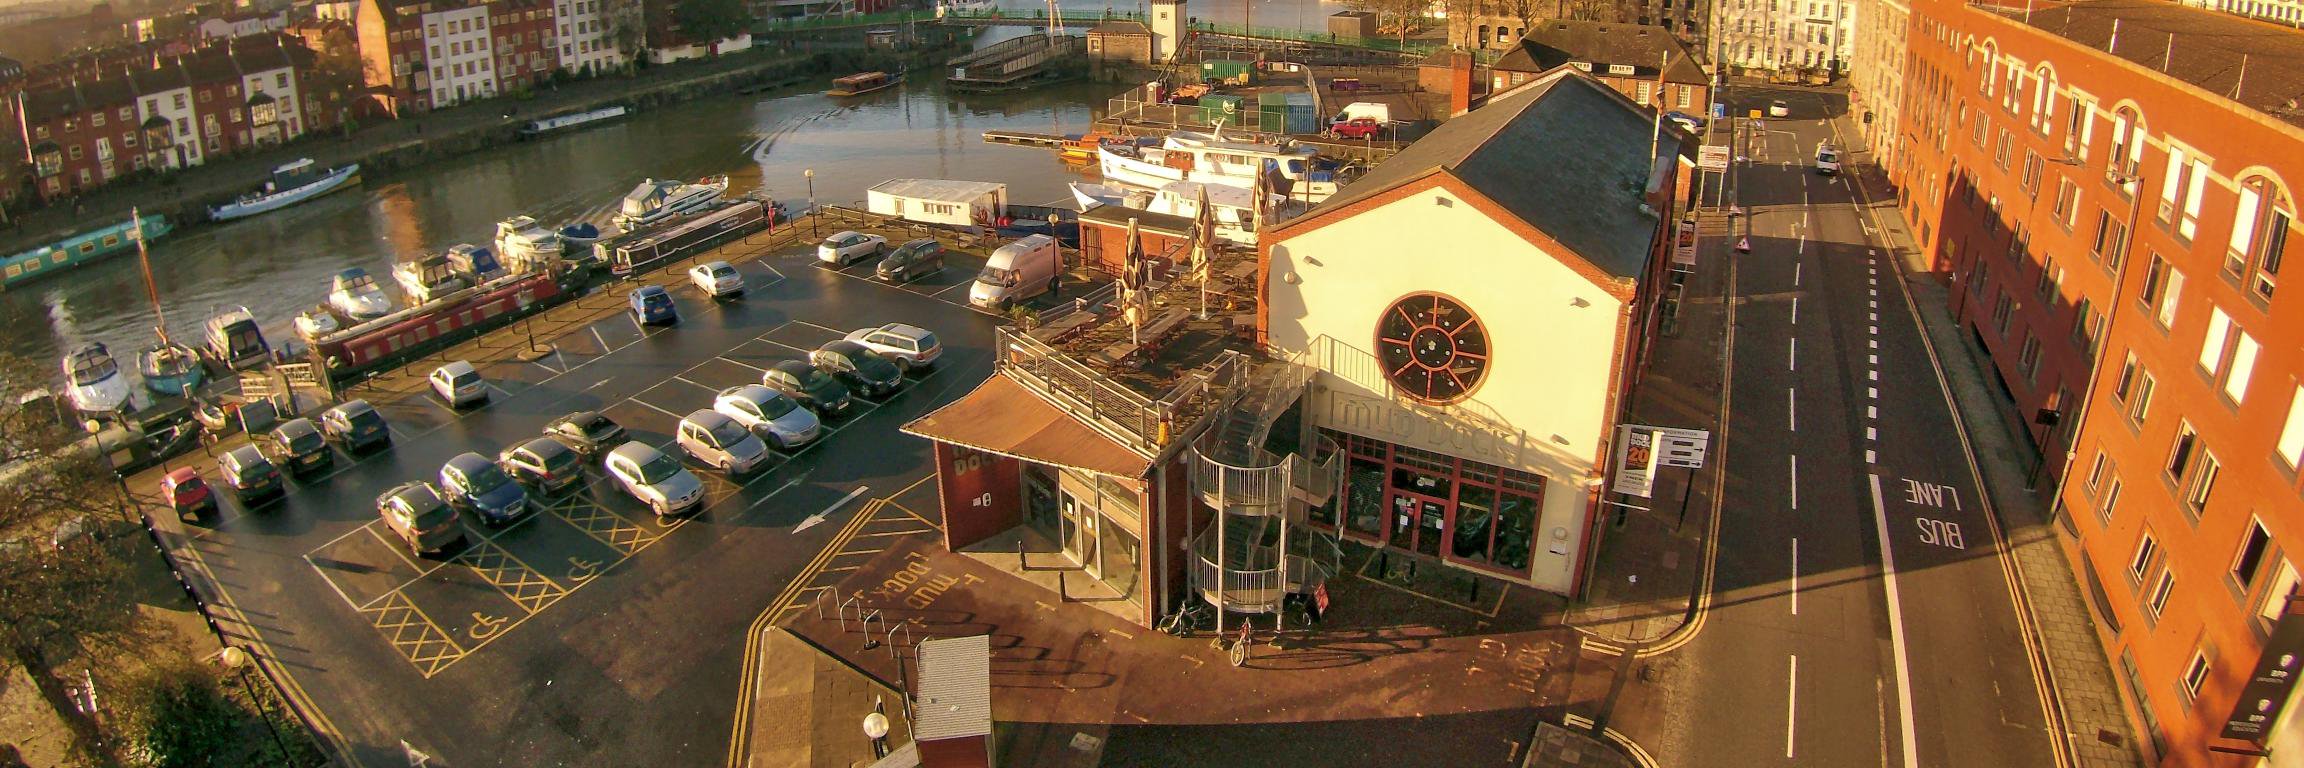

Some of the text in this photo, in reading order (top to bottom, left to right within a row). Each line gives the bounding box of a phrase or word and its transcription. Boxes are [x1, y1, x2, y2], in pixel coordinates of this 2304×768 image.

[1427, 418, 1514, 464] DOCK
[1628, 446, 1650, 463] 20
[1901, 477, 1961, 511] LANE
[1916, 517, 1965, 550] BUS
